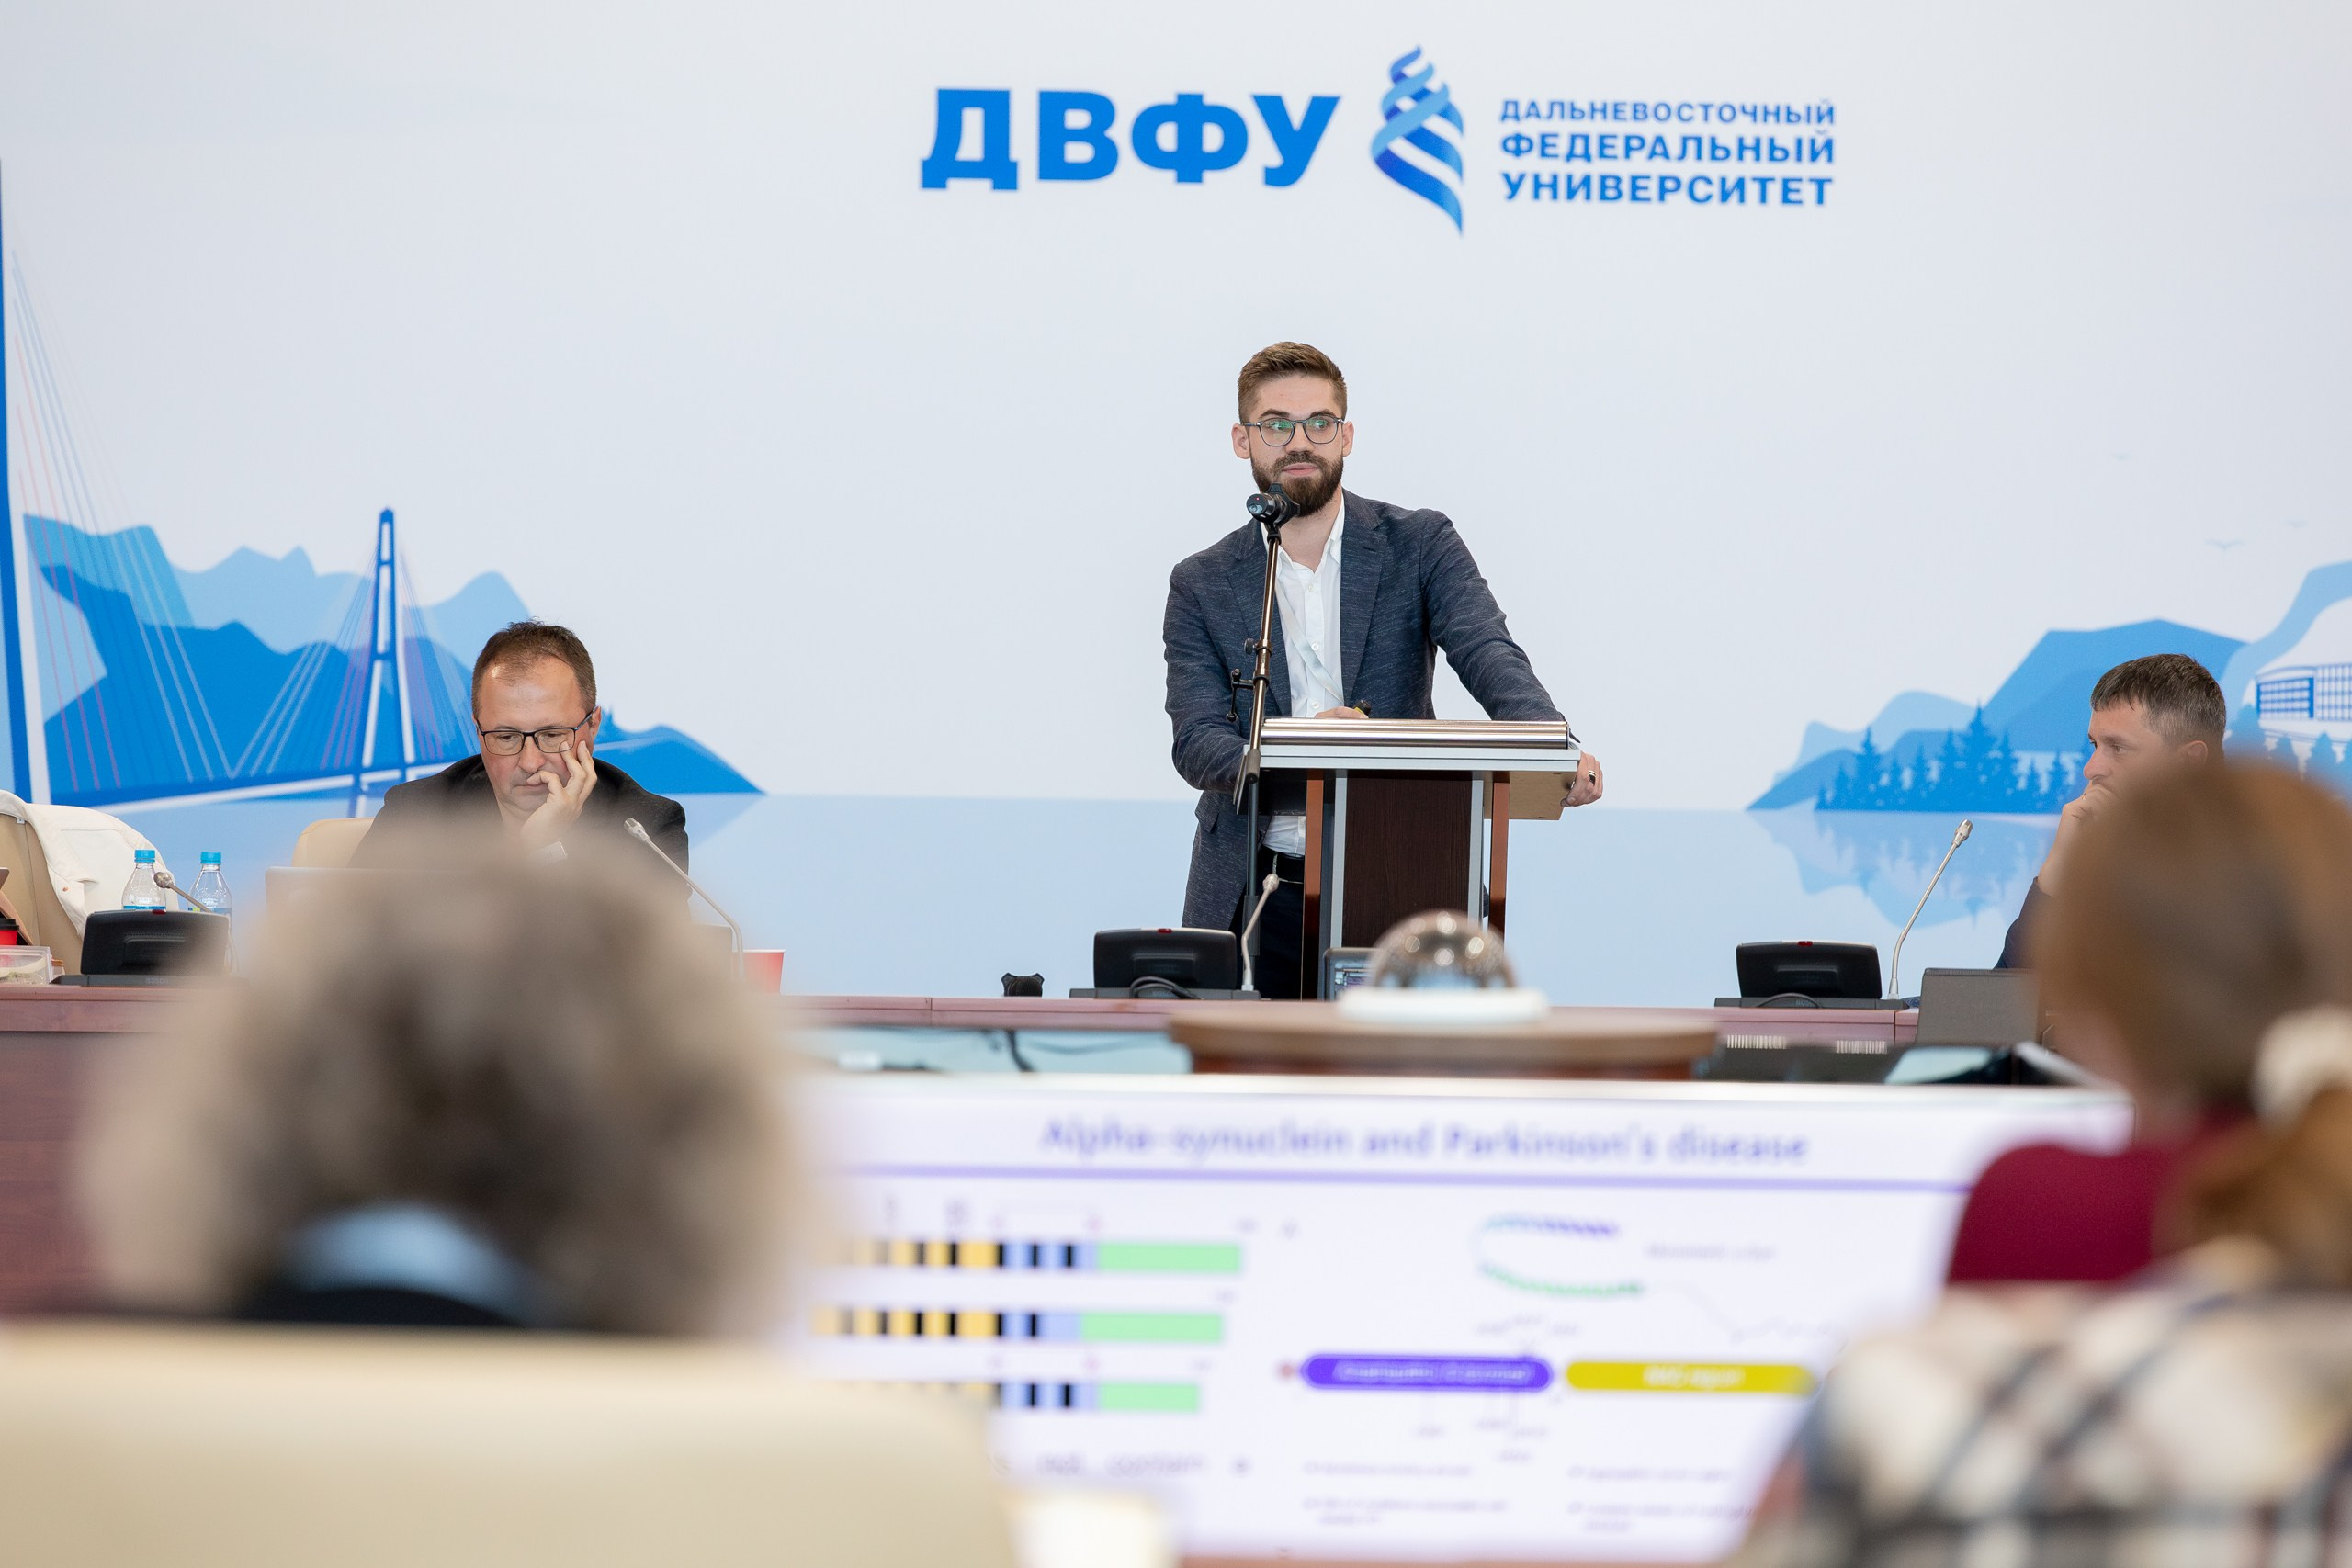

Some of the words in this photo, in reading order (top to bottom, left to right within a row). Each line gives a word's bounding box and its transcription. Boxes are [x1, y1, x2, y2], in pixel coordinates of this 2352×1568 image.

[1499, 98, 1836, 125] ДАЛЬНЕВОСТОЧНЫЙ
[920, 87, 1341, 192] ДВФУ
[1500, 129, 1835, 164] ФЕДЕРАЛЬНЫЙ
[1501, 172, 1834, 206] УНИВЕРСИТЕТ
[1362, 1122, 1436, 1158] and
[1667, 1124, 1810, 1163] disease
